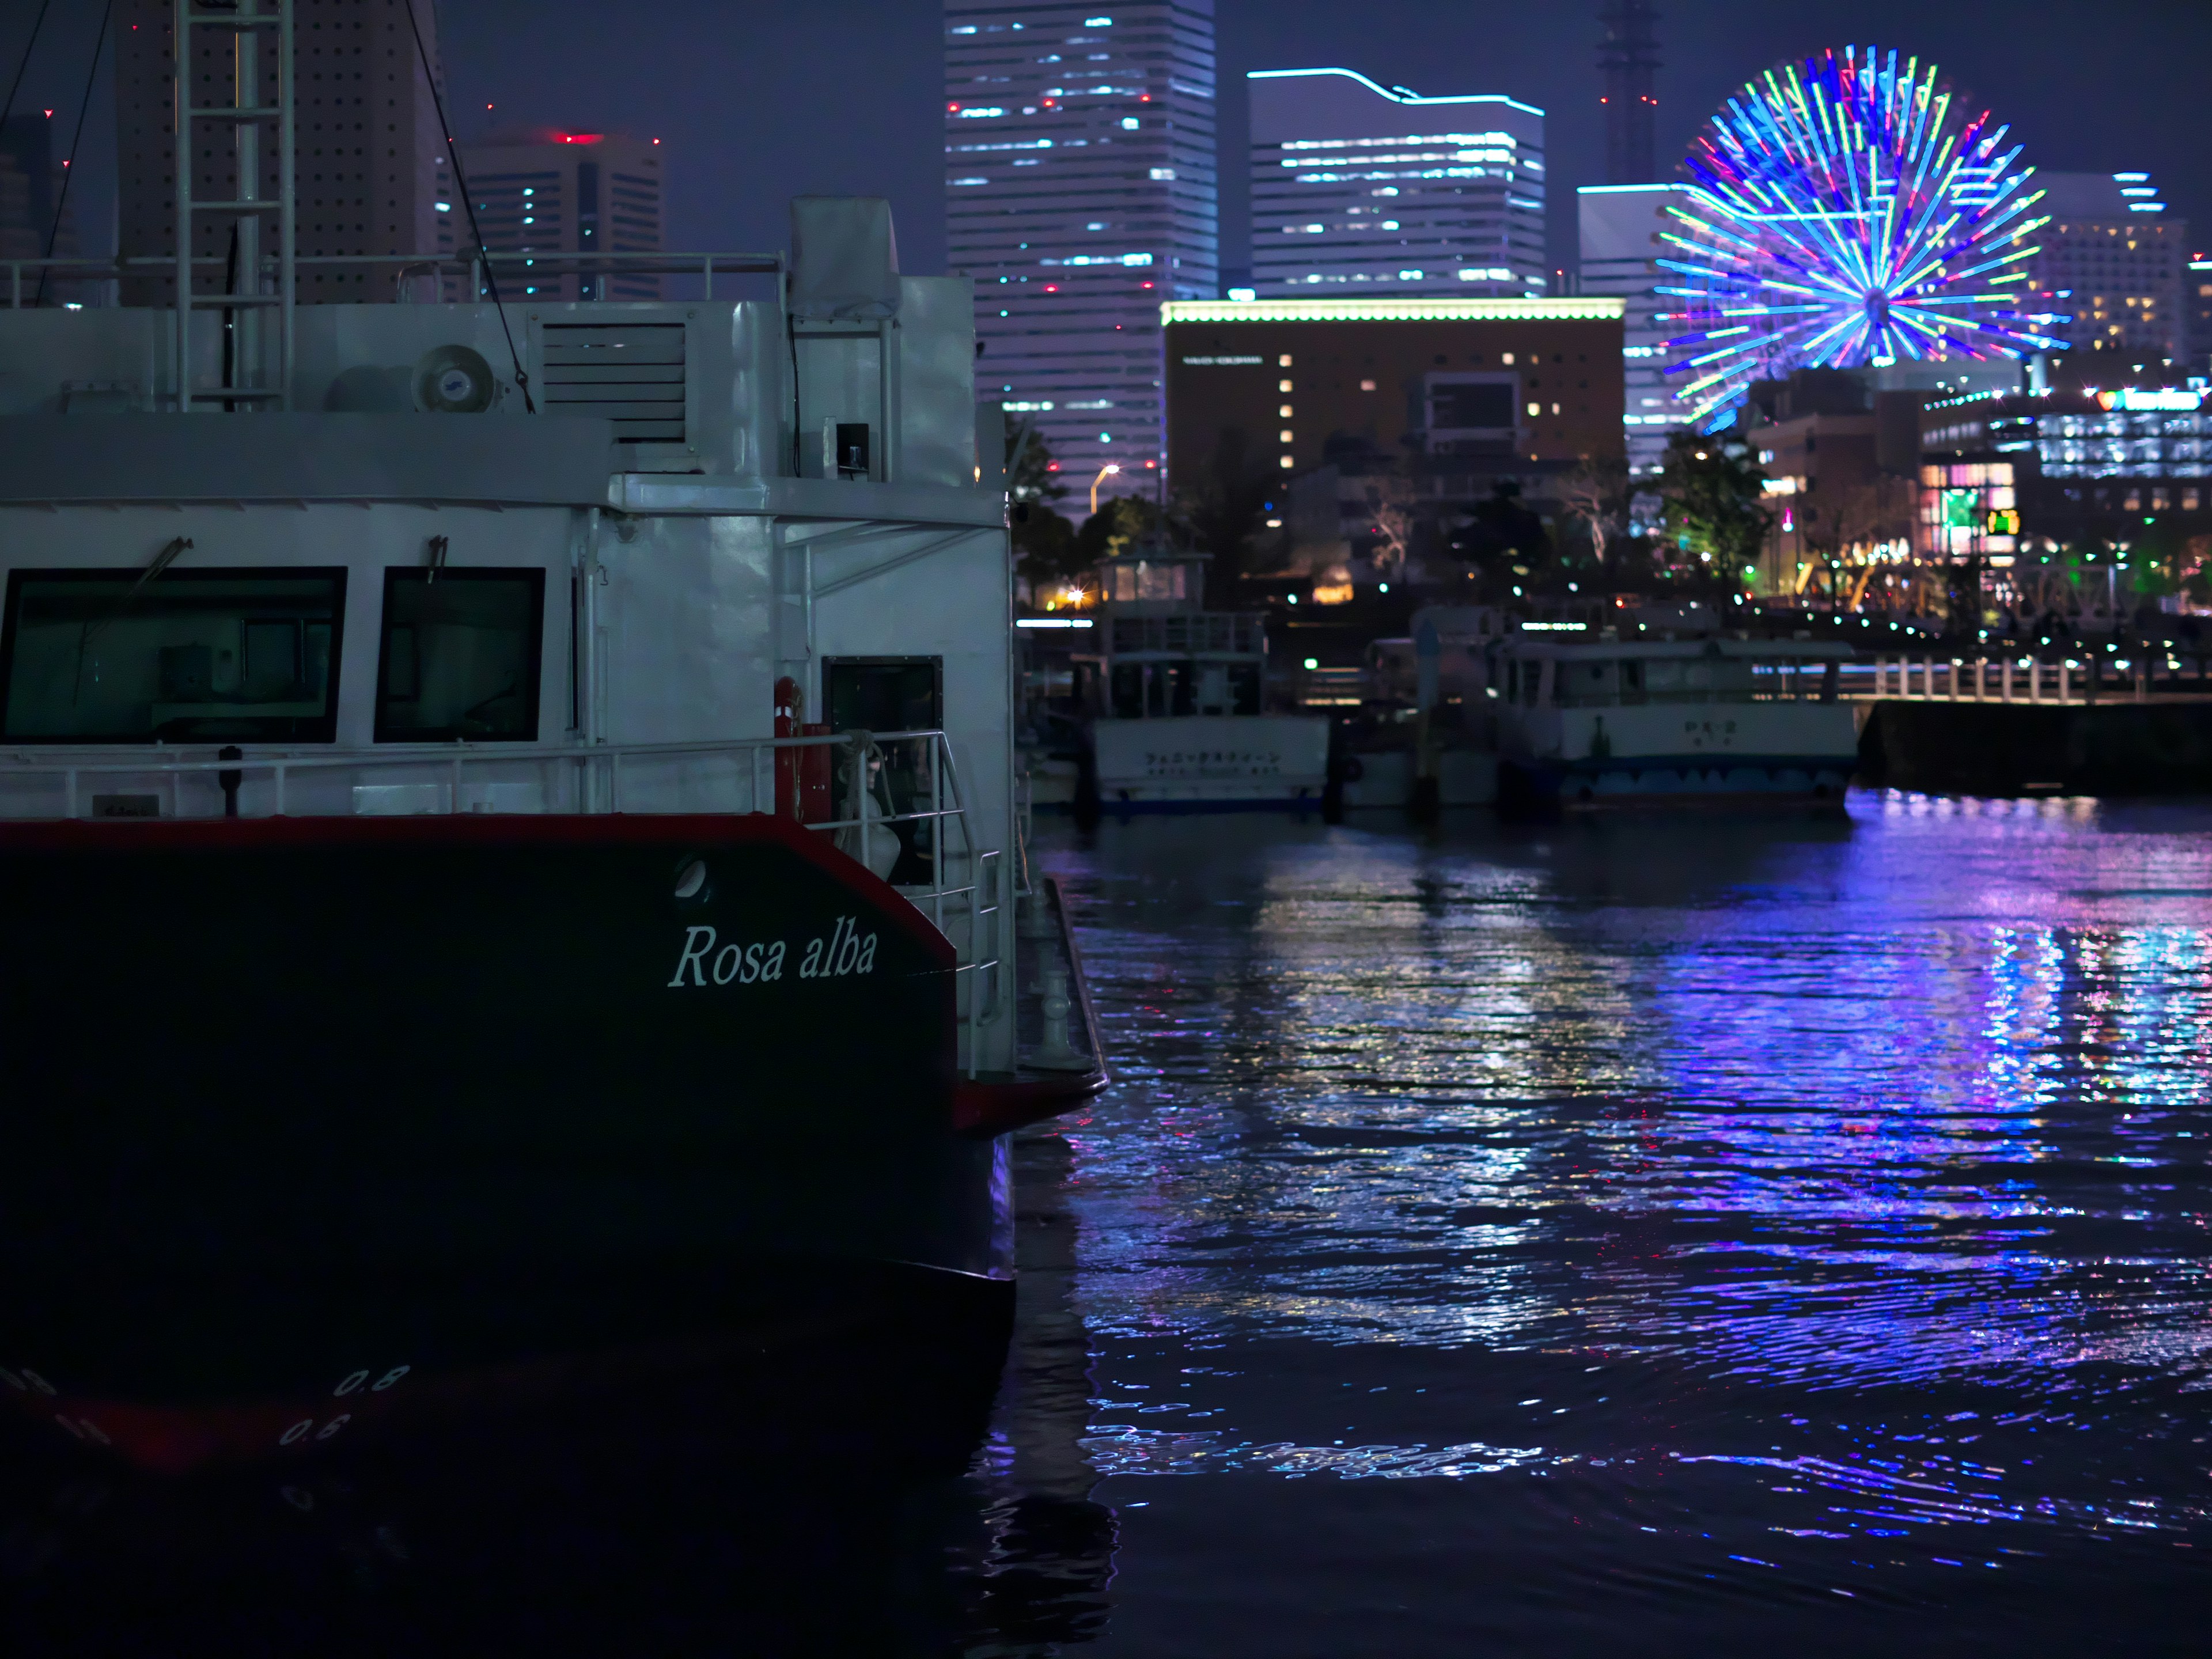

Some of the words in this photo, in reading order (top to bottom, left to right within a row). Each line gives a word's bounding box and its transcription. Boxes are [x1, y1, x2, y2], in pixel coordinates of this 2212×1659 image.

[667, 926, 786, 987] Rosa
[799, 915, 878, 979] alba
[332, 1364, 411, 1397] 0.8
[279, 1413, 351, 1446] 0.6
